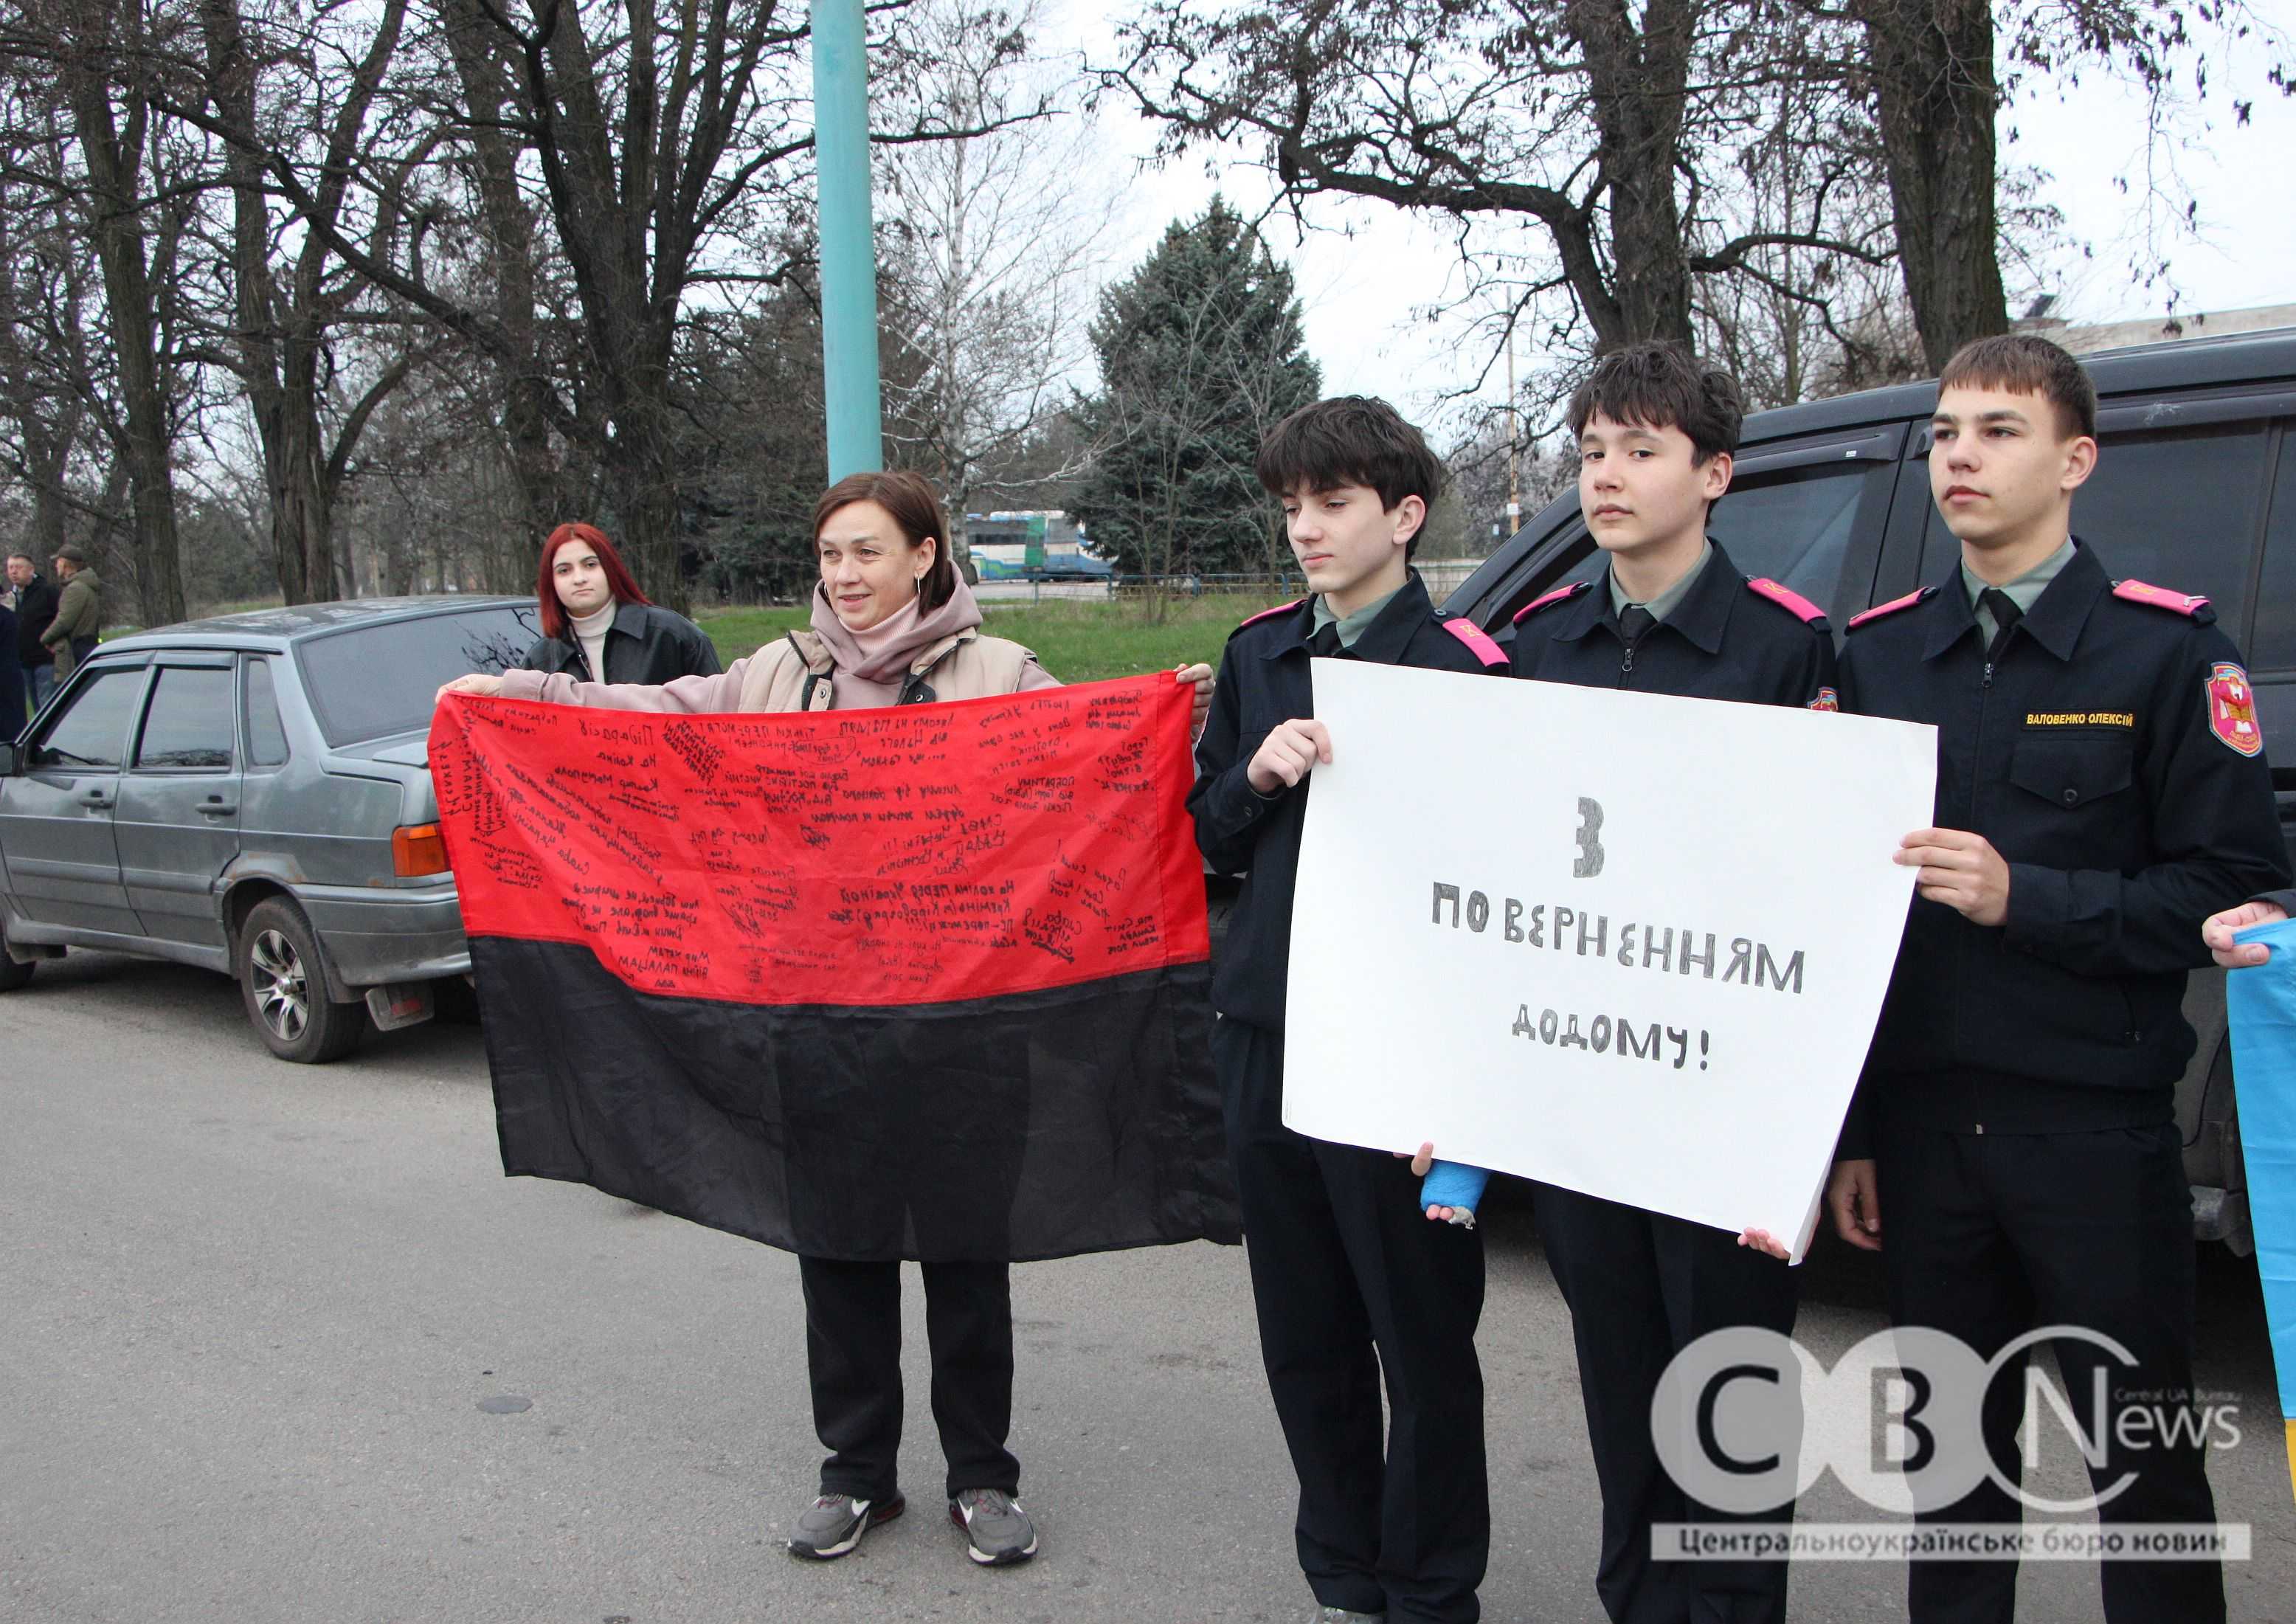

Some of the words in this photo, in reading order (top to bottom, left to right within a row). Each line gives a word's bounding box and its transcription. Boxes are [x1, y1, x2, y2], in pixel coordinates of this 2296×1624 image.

[2026, 713, 2086, 725] ВАЛОВЕНКО
[2088, 713, 2134, 727] ОЛЕКСІЙ
[1573, 796, 1605, 878] З
[1432, 881, 1805, 994] ПОВЕРНЕННЯМ
[1512, 1003, 1709, 1071] ДОДОМУ!
